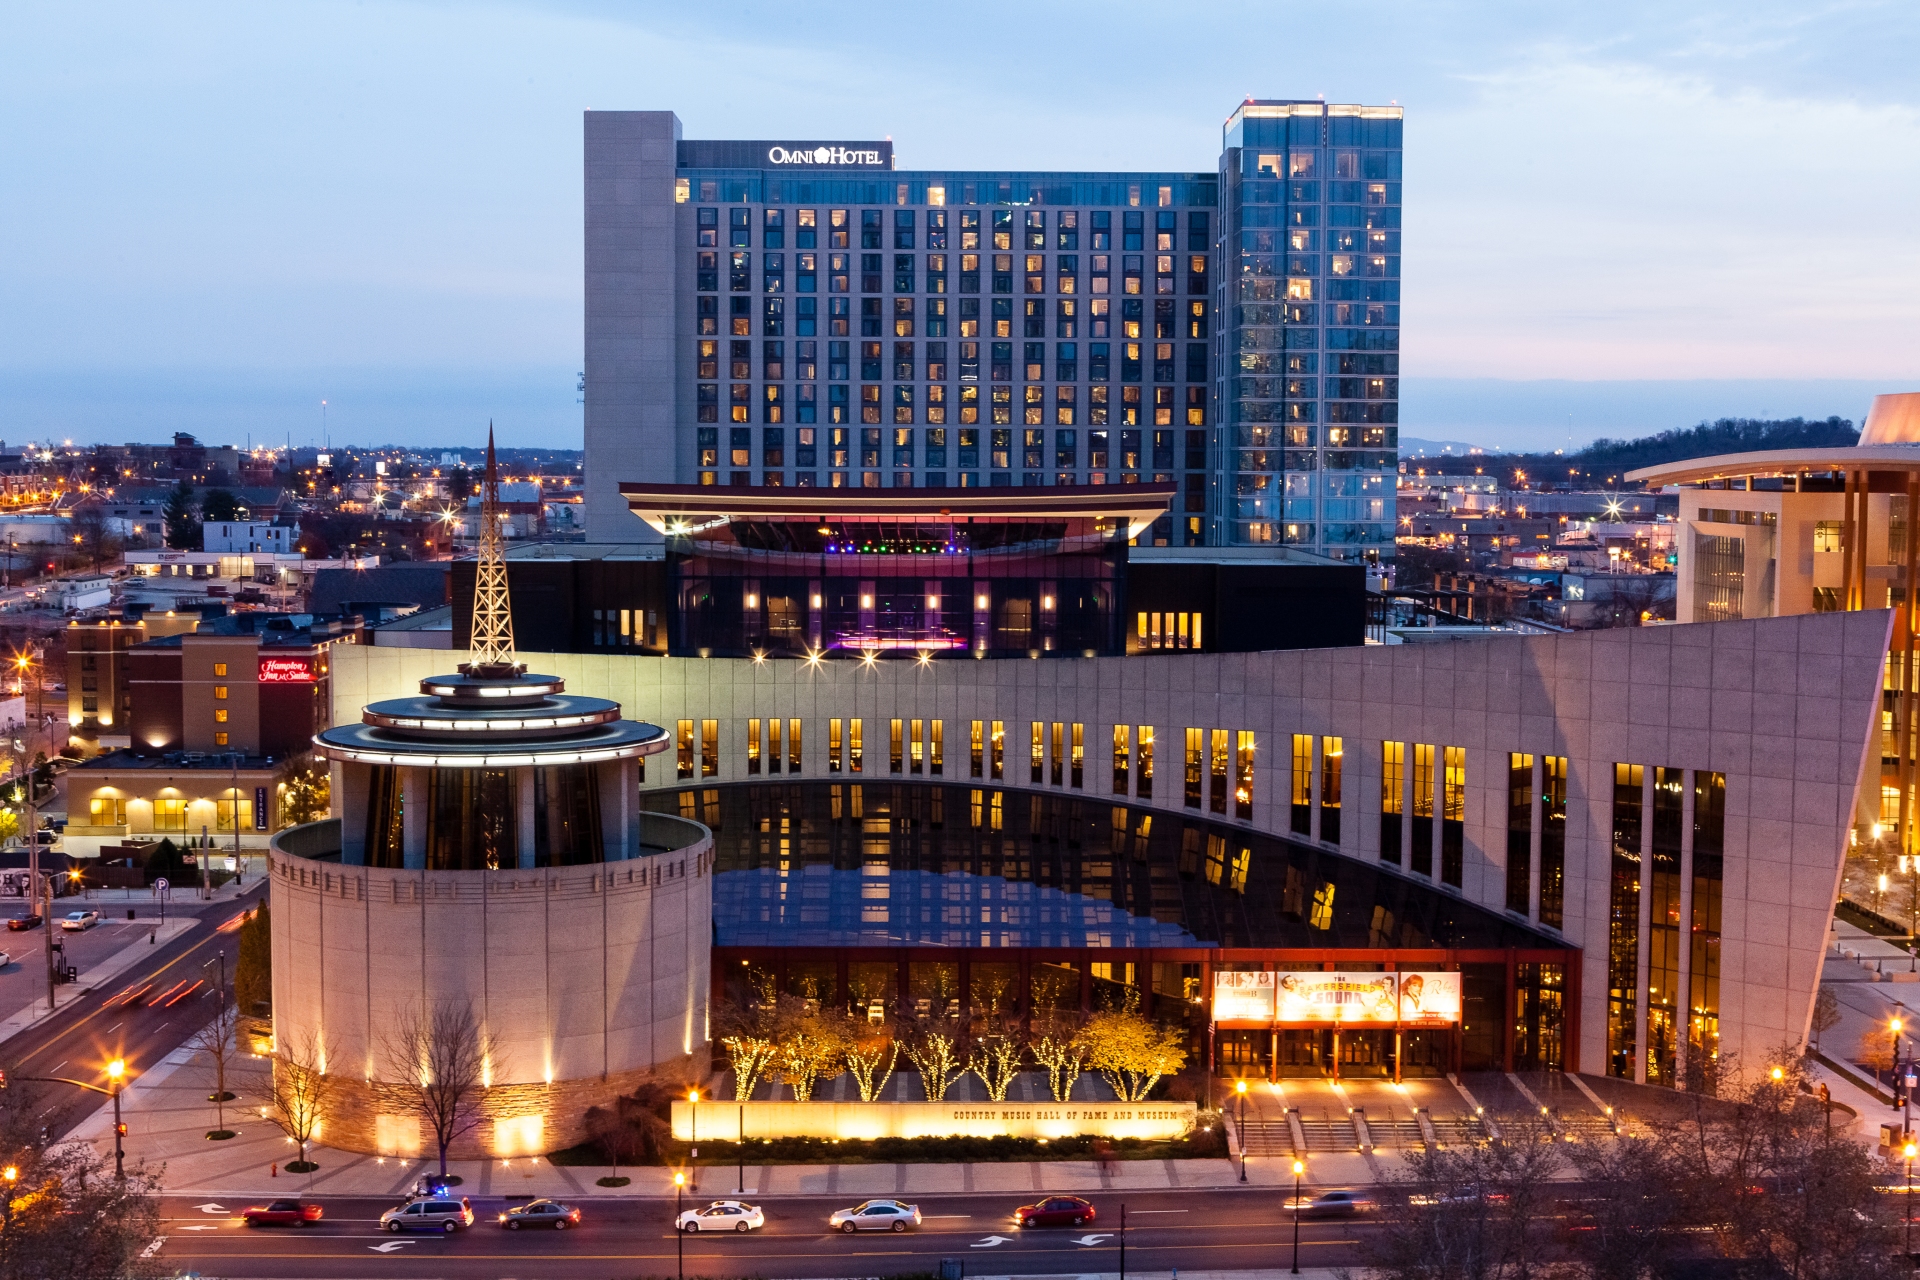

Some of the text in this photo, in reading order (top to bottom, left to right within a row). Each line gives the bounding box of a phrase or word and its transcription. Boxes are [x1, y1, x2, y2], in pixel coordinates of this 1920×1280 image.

[769, 146, 883, 164] OMNI HOTEL
[261, 660, 307, 672] Hampton
[258, 671, 280, 681] Inn
[158, 880, 166, 890] P
[1300, 982, 1376, 993] BAKERSFIELD
[1316, 991, 1362, 1004] SOUND
[954, 1111, 1177, 1120] COUNTRY MUSIC HALL OF FAME AND MUSEUM
